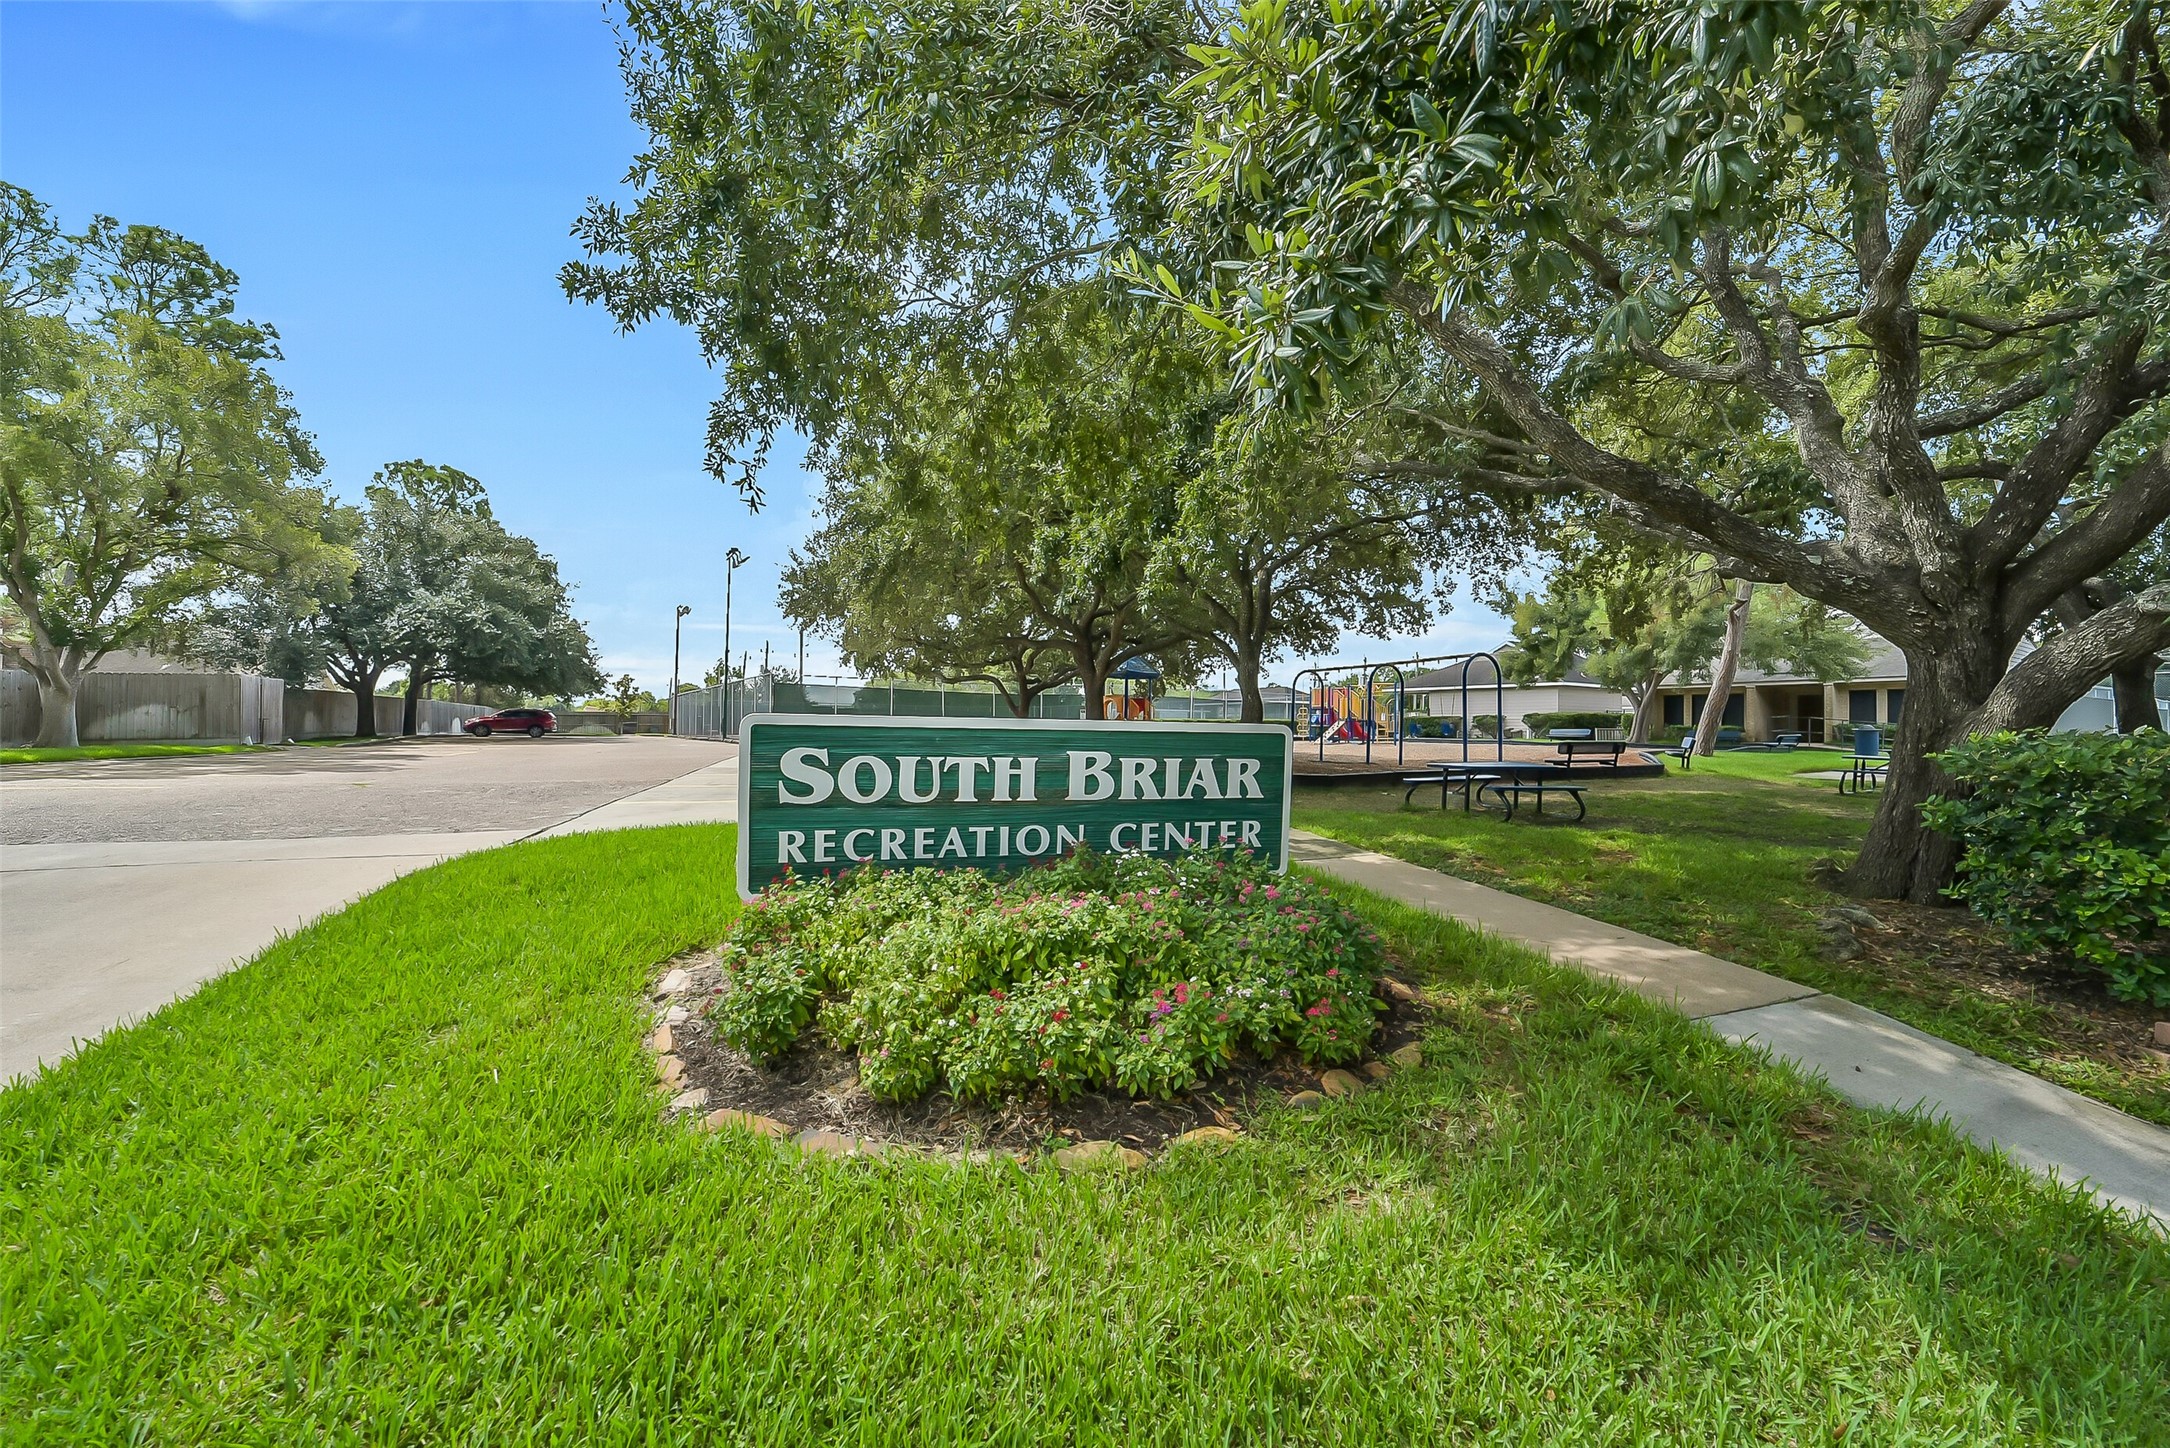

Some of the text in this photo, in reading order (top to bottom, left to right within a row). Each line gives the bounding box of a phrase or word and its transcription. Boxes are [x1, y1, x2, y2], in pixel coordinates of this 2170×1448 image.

[778, 747, 1265, 804] SOUTH BRIAR
[777, 820, 1263, 864] RECREATION CENTER
